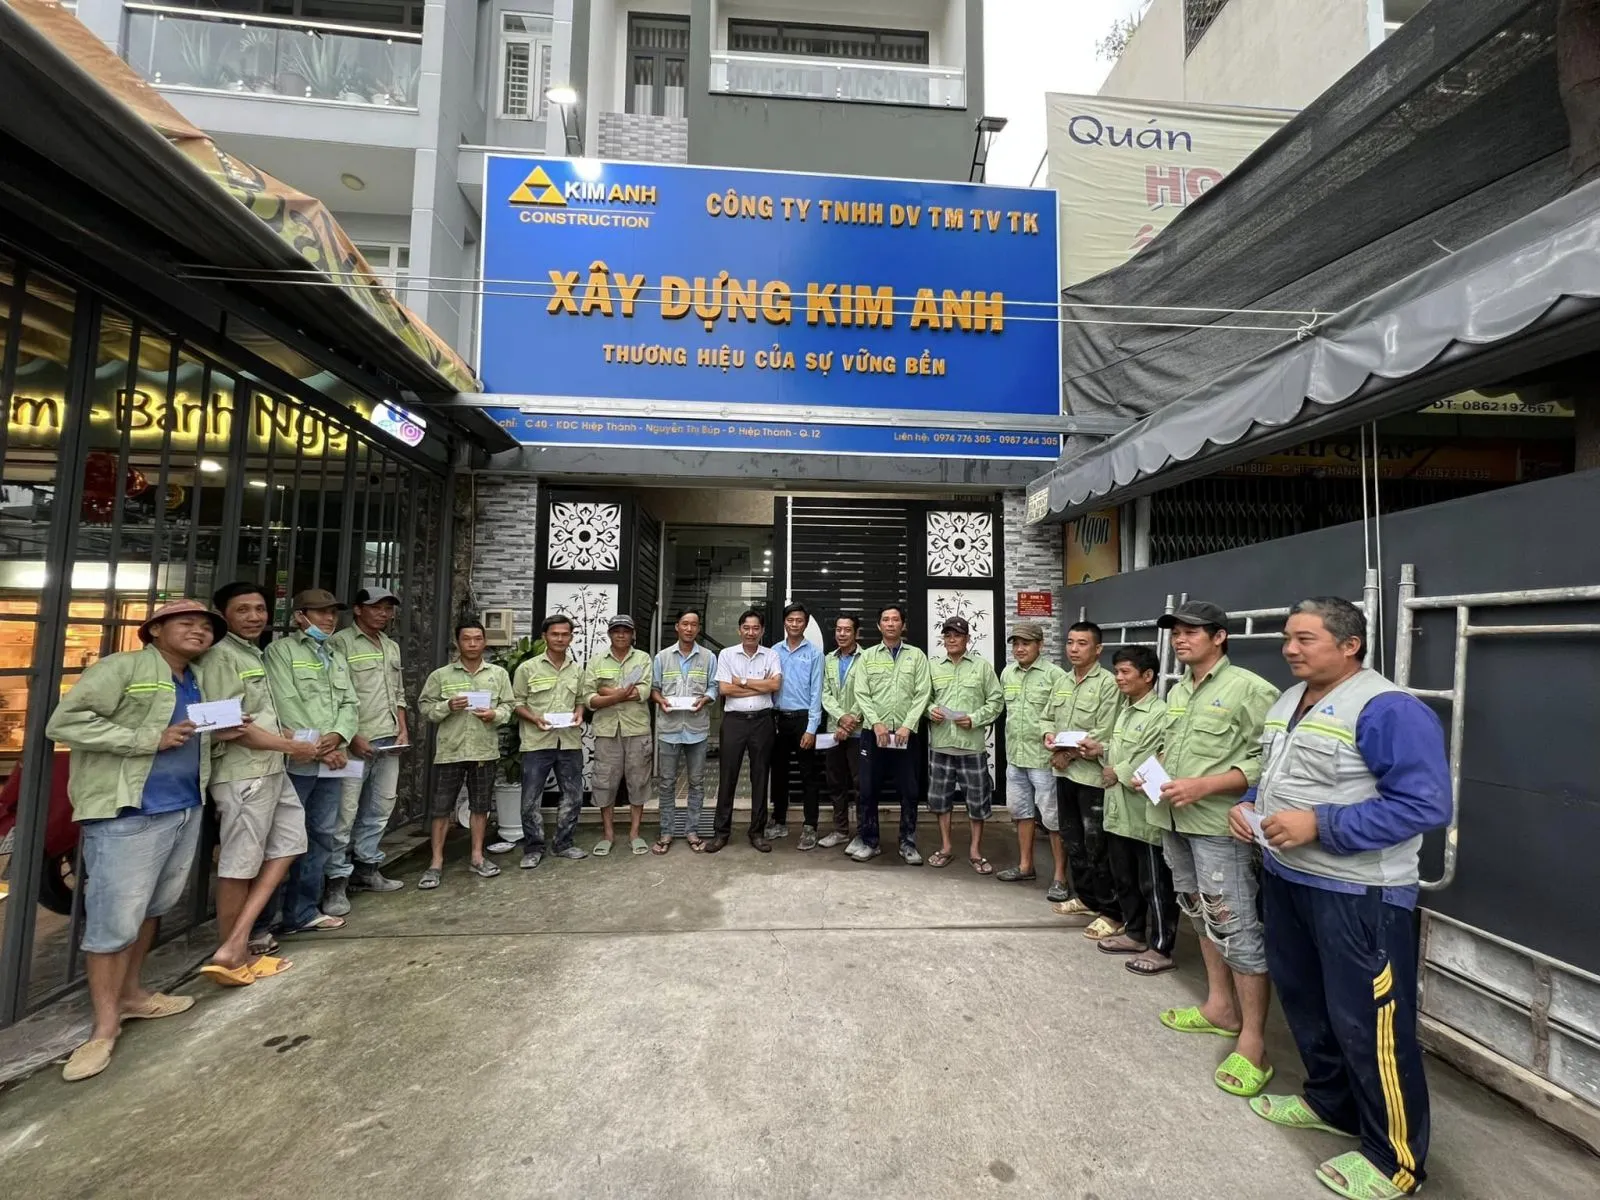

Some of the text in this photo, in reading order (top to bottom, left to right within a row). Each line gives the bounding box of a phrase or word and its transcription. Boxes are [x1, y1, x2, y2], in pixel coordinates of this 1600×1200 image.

[1068, 115, 1192, 152] Quán
[565, 181, 657, 205] KIM ANH
[519, 211, 650, 228] CONSTRUCTION
[706, 188, 1039, 235] CÔNG TY TNHH DV TM TV TK
[546, 260, 1004, 333] XÂY DỰNG KIM ANH
[602, 343, 946, 377] THƯƠNG HIỆU CỦA SỰ VỮNG BỀN
[556, 420, 579, 430] KDC
[933, 433, 955, 443] 0974
[957, 434, 973, 443] 776
[974, 434, 991, 444] 305
[999, 435, 1020, 445] 0987
[1022, 436, 1040, 445] 244
[1041, 436, 1058, 446] 305
